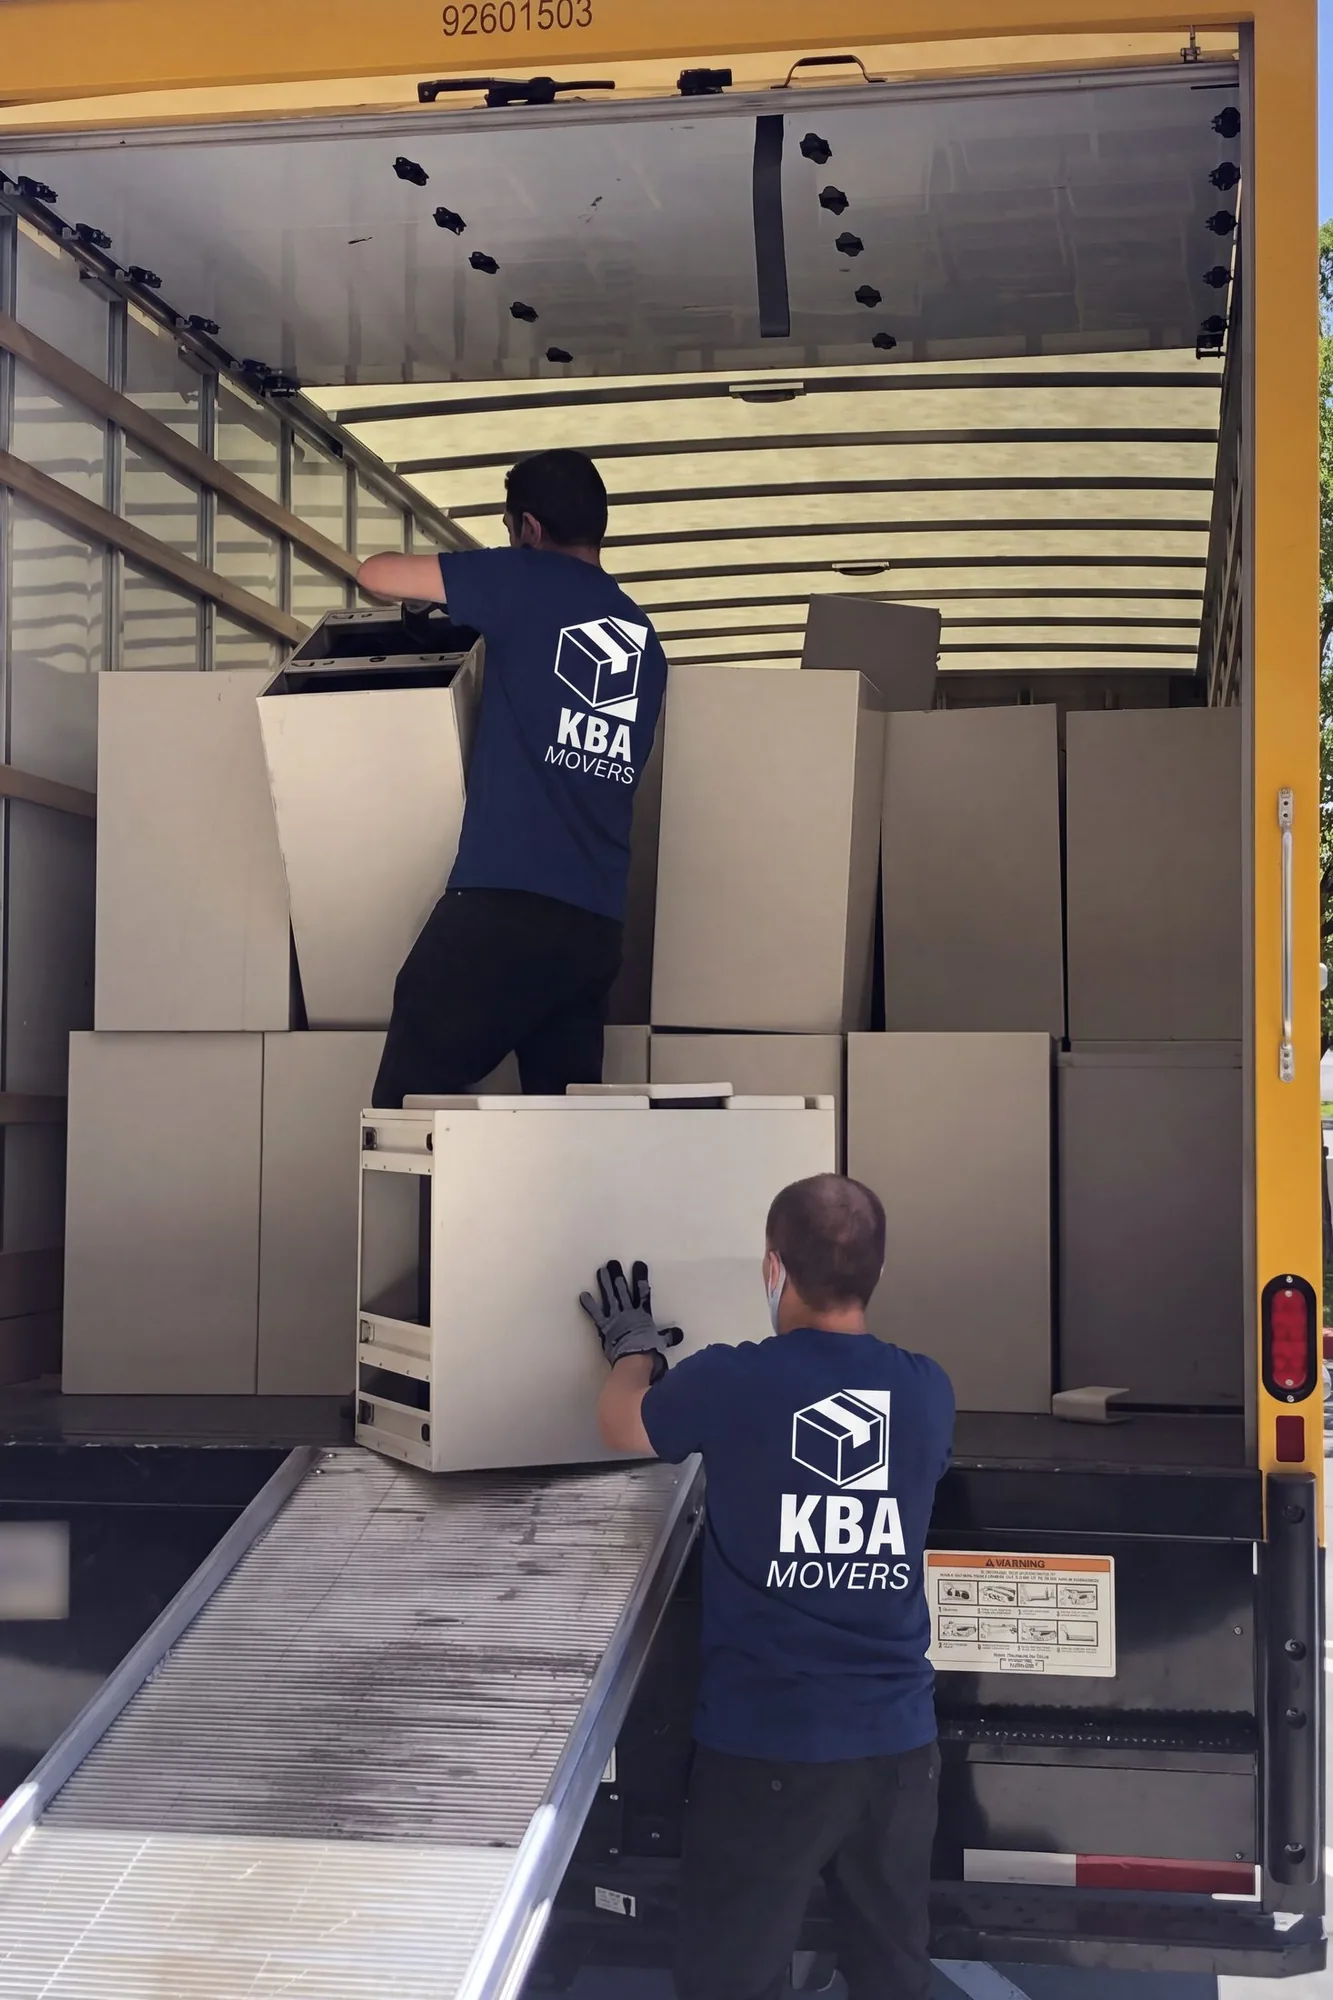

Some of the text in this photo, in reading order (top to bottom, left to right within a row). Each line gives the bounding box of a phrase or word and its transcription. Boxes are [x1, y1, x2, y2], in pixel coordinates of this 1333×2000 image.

[442, 0, 593, 37] 92601503
[557, 706, 632, 763] KBA
[544, 745, 635, 784] MOVERS
[779, 1493, 906, 1556] KBA
[766, 1560, 911, 1590] MOVERS
[995, 1558, 1046, 1569] WARNING
